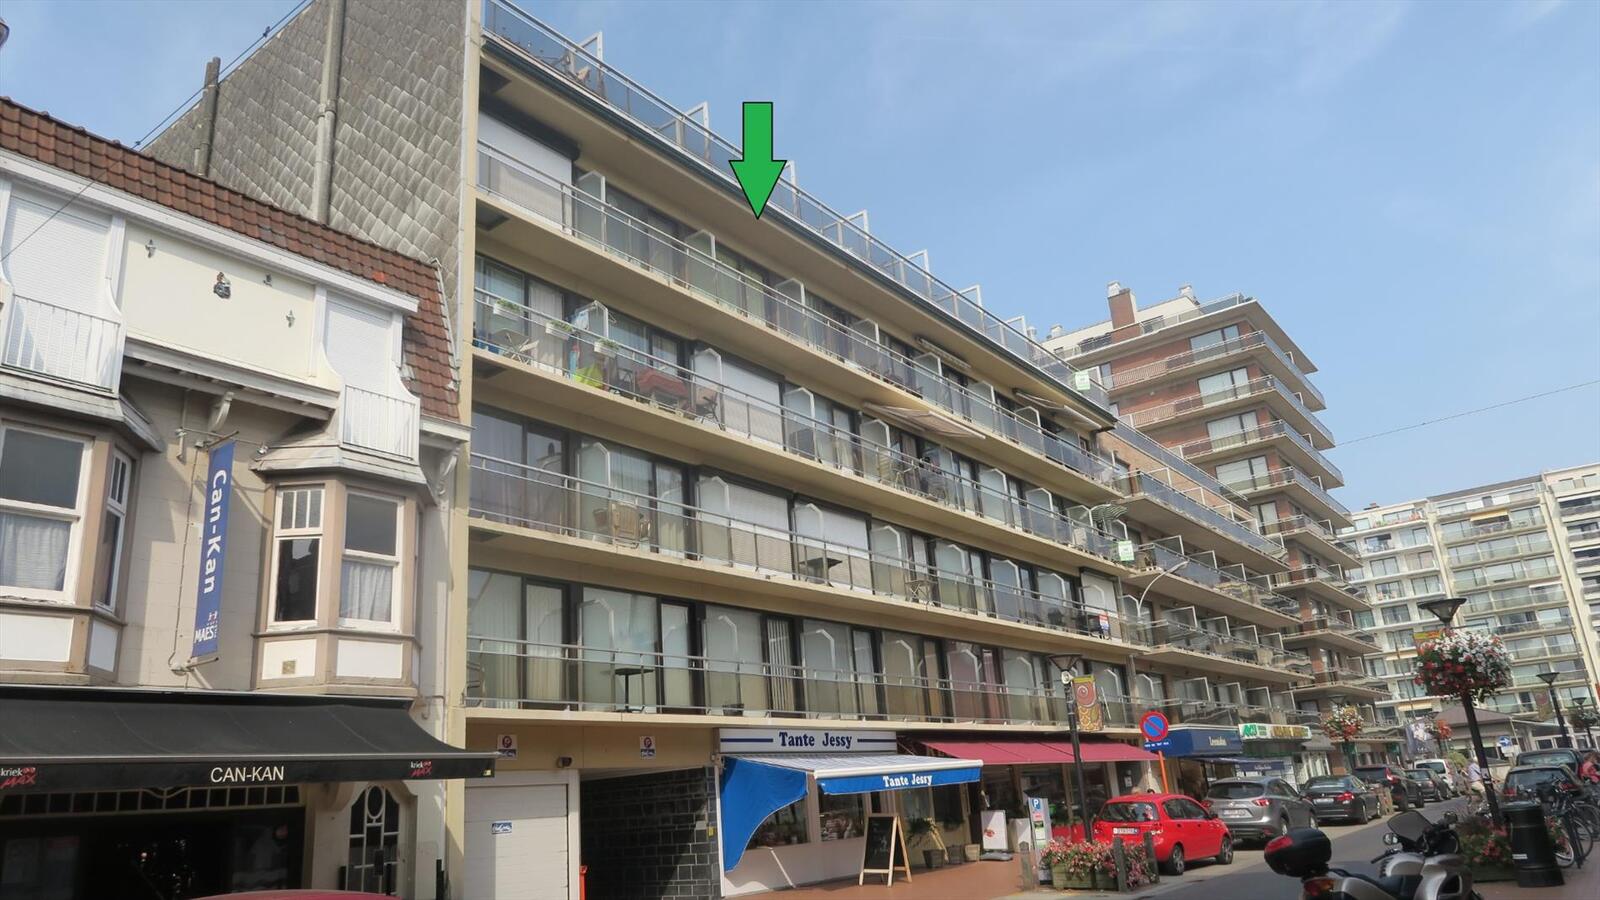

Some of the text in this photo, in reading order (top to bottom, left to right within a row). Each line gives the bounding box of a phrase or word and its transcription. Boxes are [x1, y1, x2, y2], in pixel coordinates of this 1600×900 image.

[203, 469, 227, 594] Can-Kan
[194, 625, 214, 643] MAES
[779, 732, 852, 749] Tante Jessy
[0, 767, 23, 777] kriek
[210, 766, 285, 783] CAN-KAN
[882, 773, 933, 788] Tante Jessy
